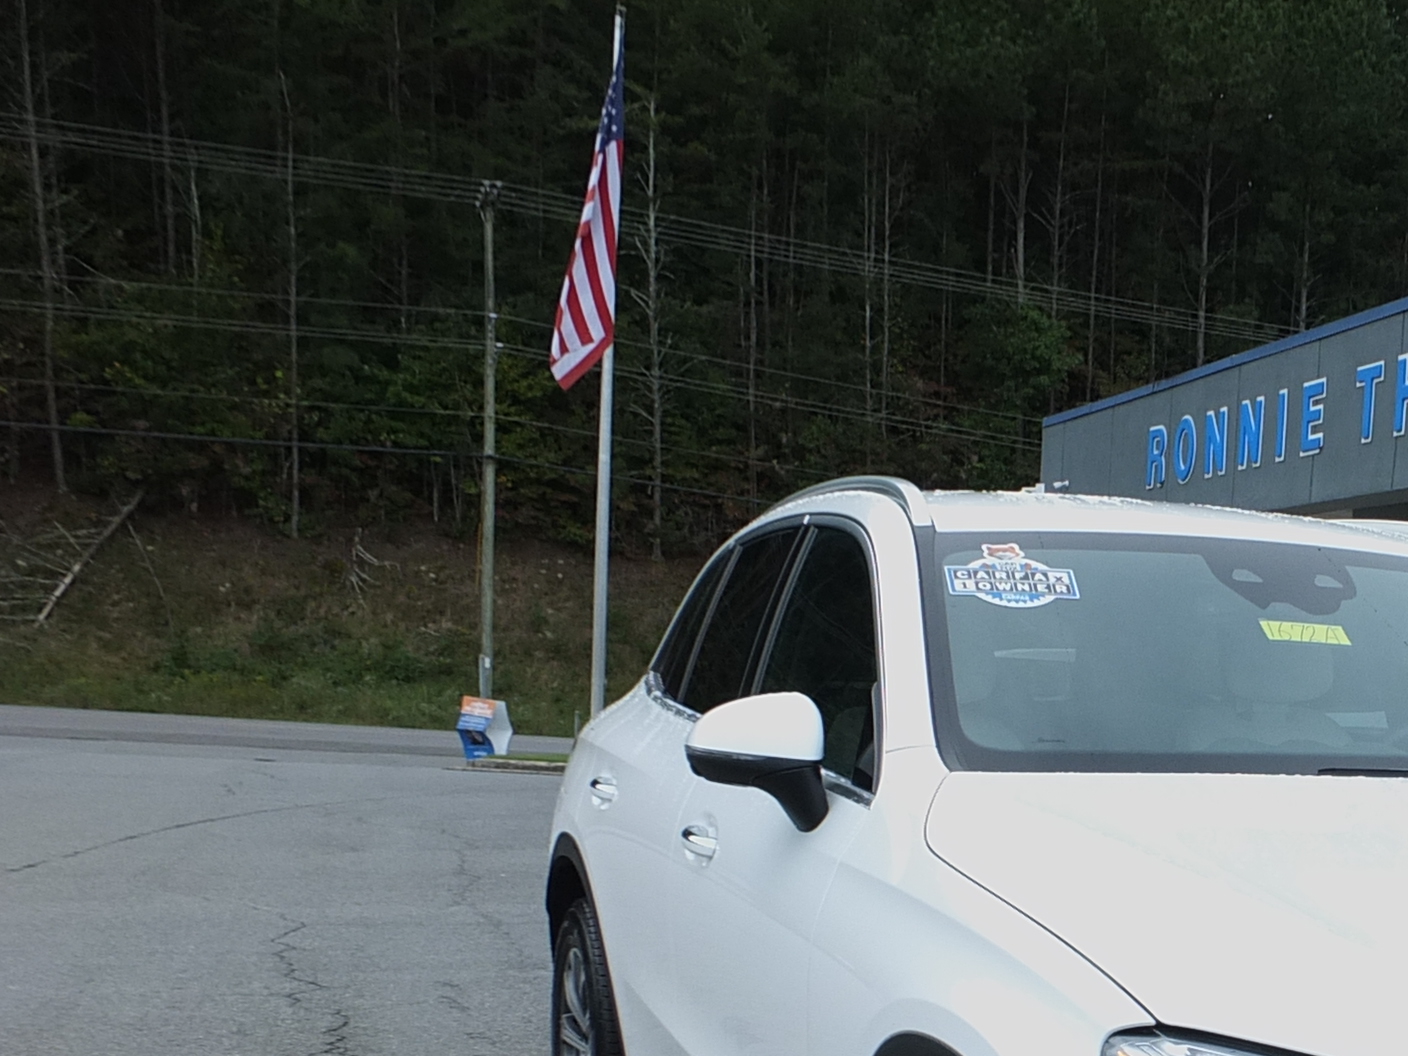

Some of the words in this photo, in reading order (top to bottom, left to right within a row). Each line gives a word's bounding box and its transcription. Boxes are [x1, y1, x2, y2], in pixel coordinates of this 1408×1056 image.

[1145, 376, 1327, 489] RONNIE
[956, 570, 1067, 584] CARFAX
[978, 582, 1069, 594] OWNER
[1266, 621, 1342, 645] 1672A
